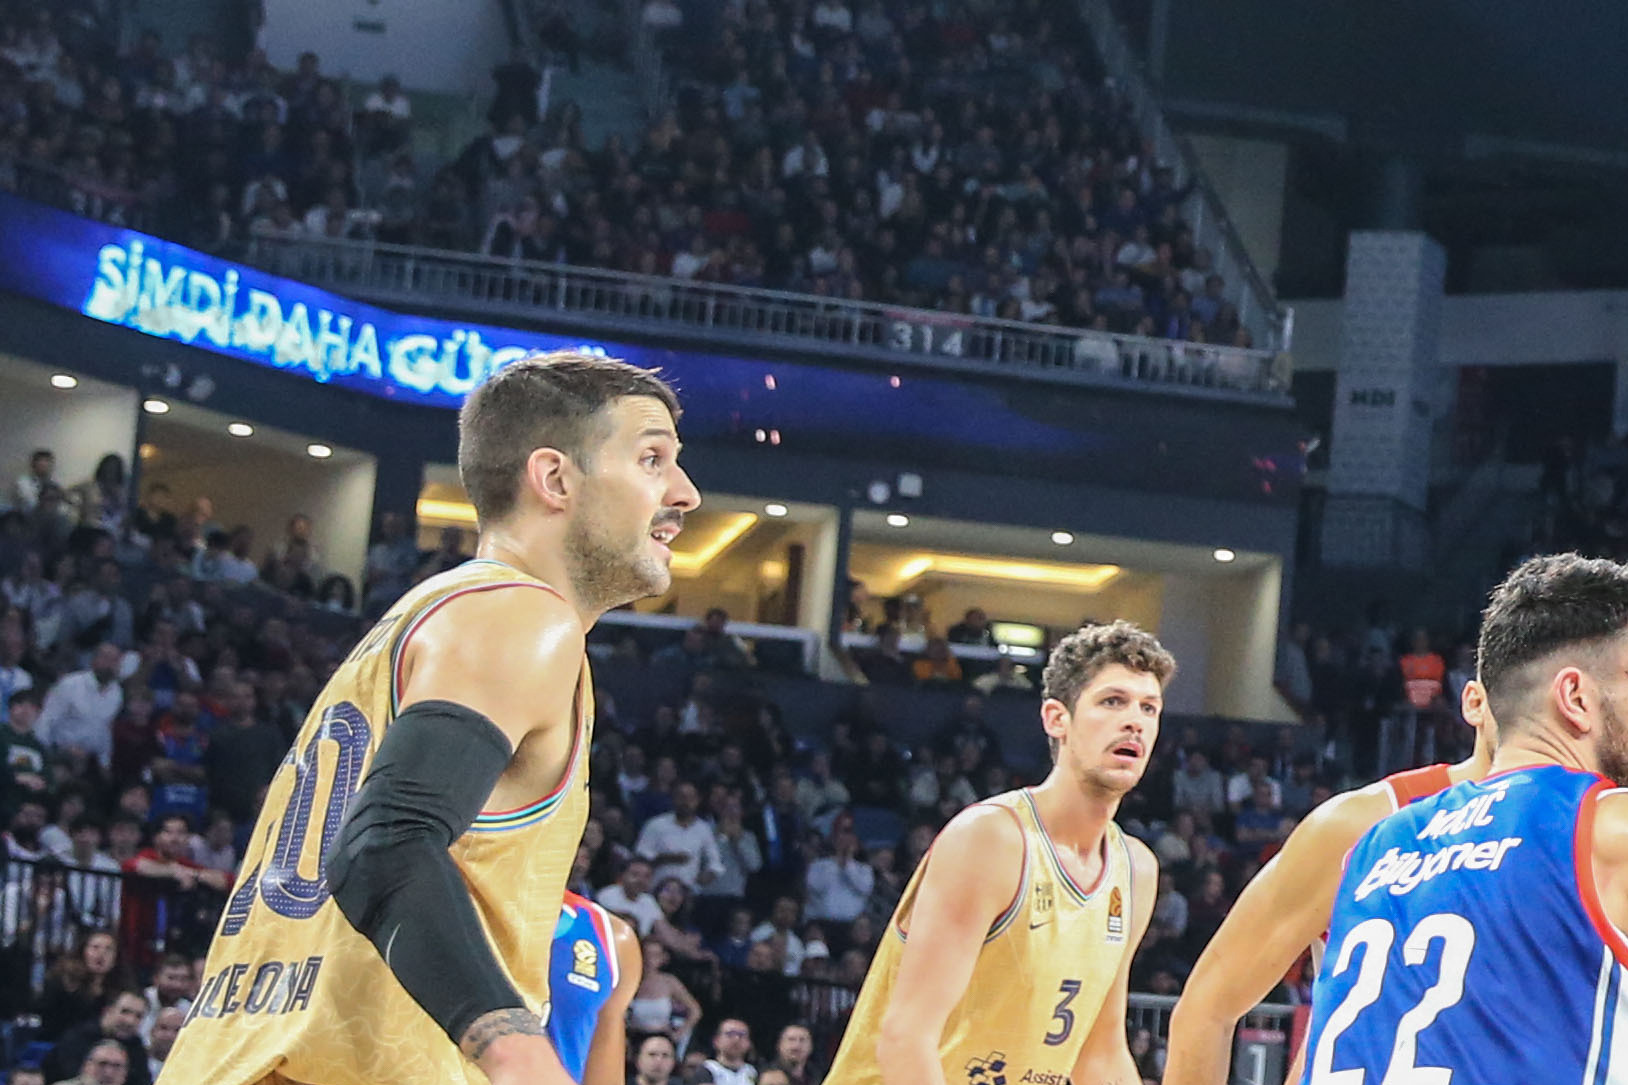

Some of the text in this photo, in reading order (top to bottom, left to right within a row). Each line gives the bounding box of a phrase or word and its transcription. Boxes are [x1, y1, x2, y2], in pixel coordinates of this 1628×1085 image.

[235, 290, 383, 382] DAHA
[1354, 837, 1522, 902] Bilyoner
[1043, 979, 1082, 1046] 3
